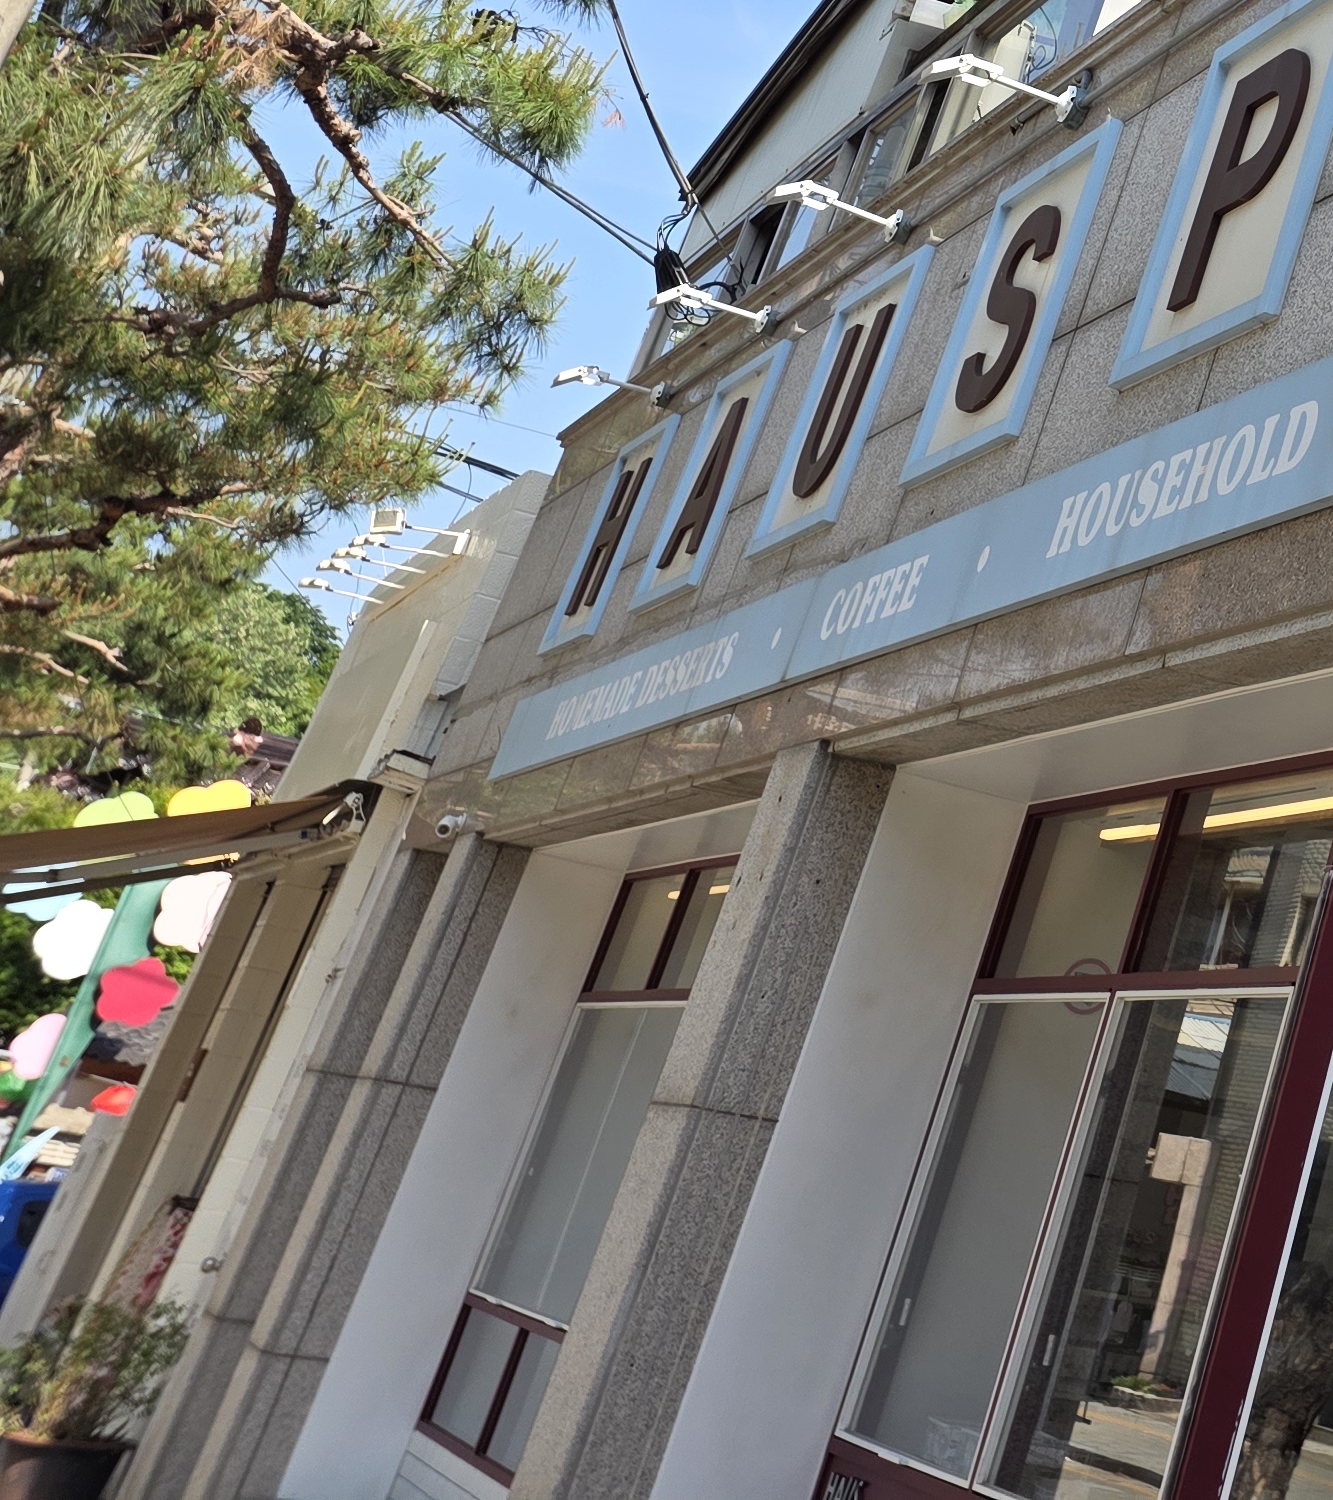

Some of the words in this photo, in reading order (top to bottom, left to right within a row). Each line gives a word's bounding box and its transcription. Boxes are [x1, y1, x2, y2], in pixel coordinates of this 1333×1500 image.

[546, 670, 643, 740] HOMEMADE
[634, 631, 739, 709] DESSERTS
[820, 554, 930, 641] COFFEE
[1045, 400, 1319, 559] HOUSEHOLD
